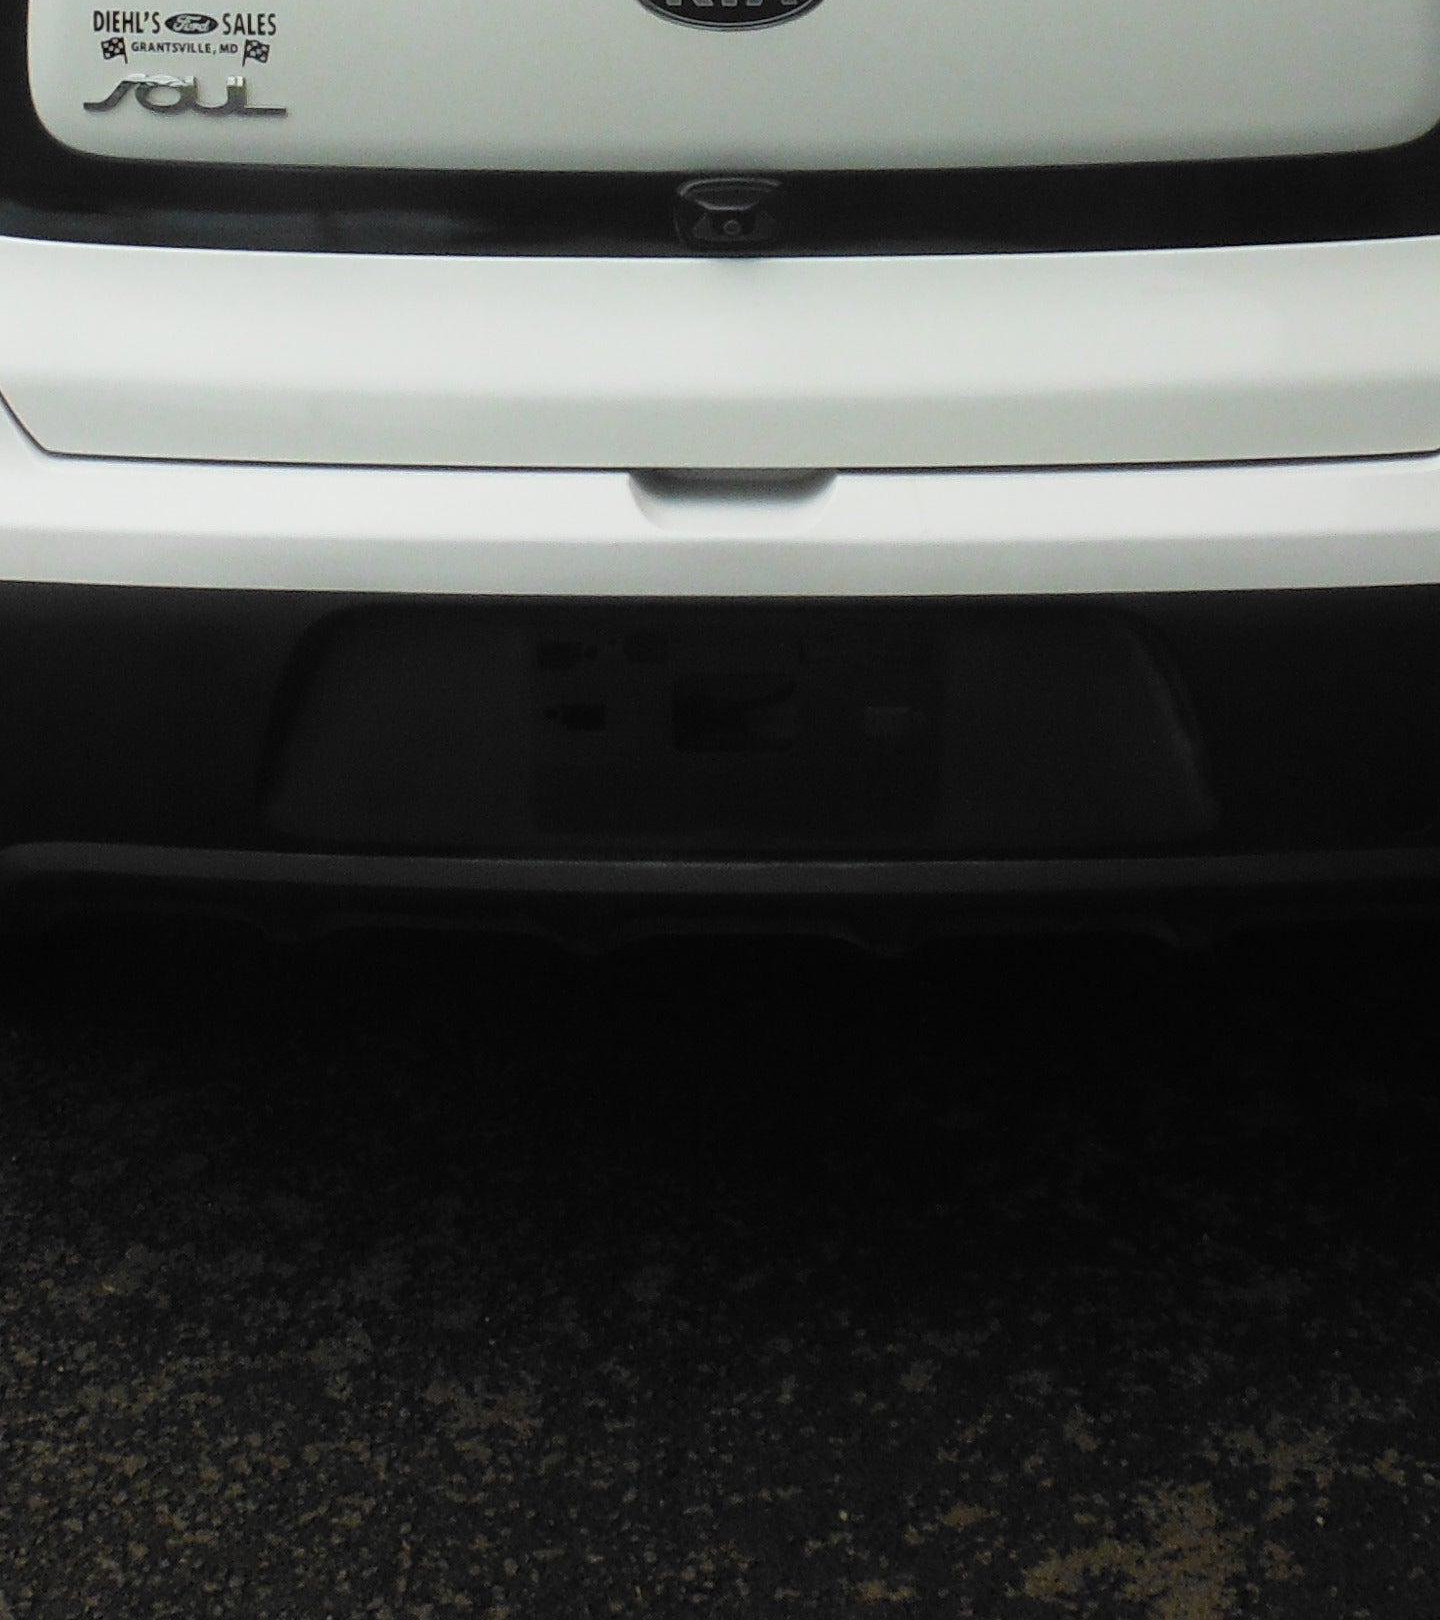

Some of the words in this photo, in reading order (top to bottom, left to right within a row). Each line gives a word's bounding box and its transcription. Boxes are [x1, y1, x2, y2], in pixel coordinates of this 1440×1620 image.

[93, 10, 161, 34] DIEHL'S
[170, 14, 213, 34] Ford
[222, 13, 277, 36] SALES
[131, 41, 216, 55] GRANTSVILLE,
[219, 43, 239, 54] MD
